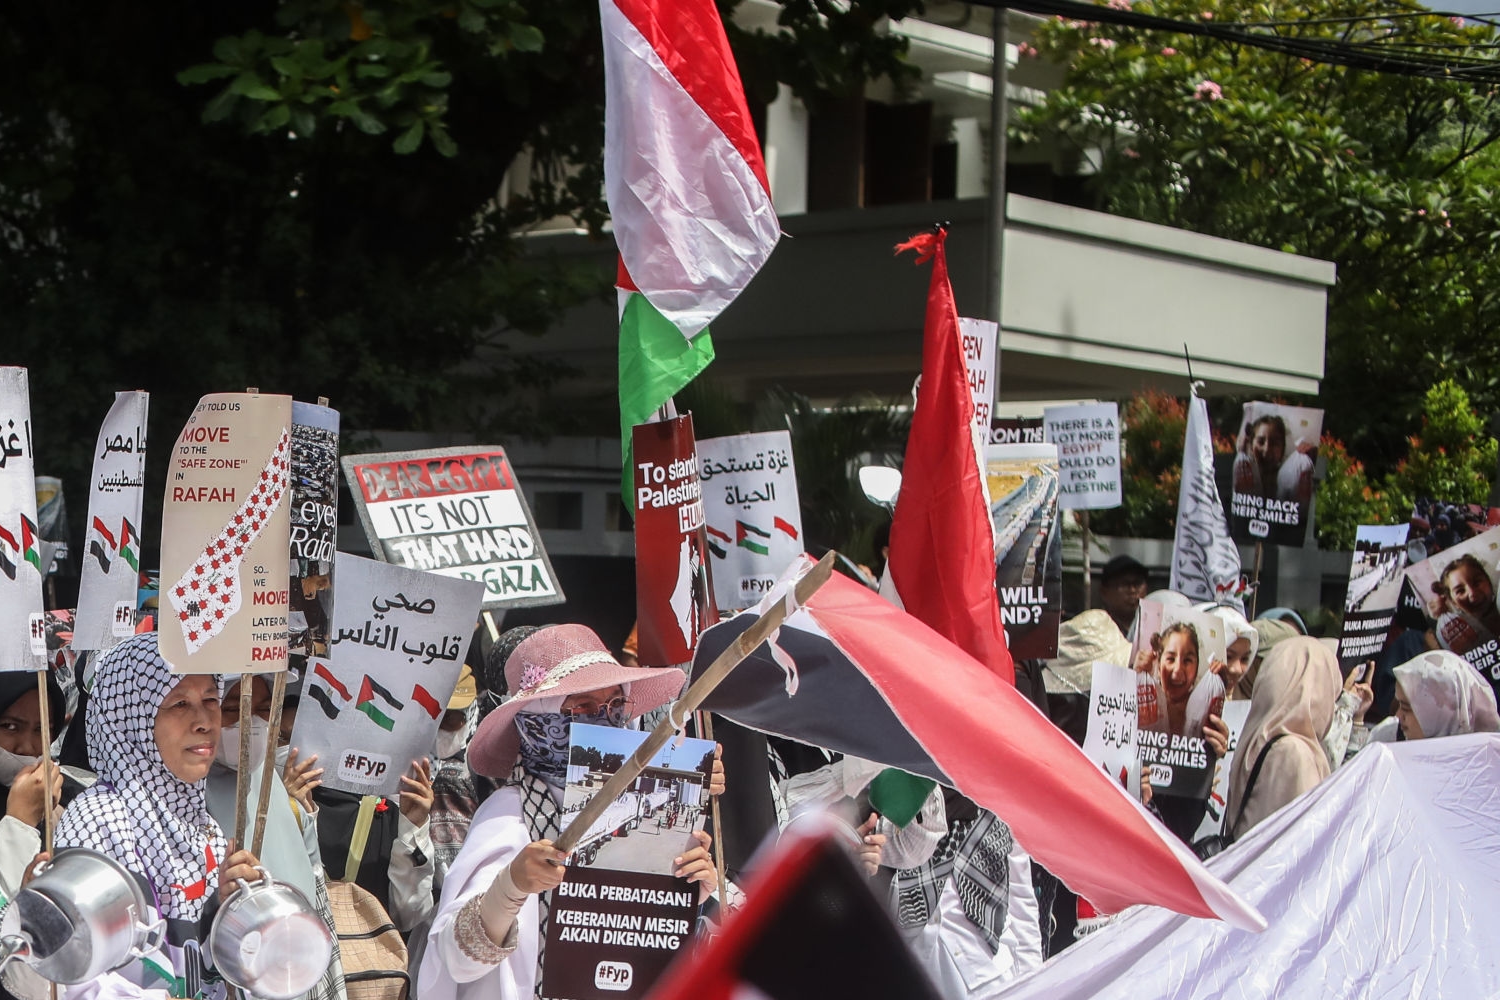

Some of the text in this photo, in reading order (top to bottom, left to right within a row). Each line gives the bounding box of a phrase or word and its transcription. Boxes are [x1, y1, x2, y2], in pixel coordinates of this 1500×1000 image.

[963, 335, 983, 360] PEN
[208, 403, 227, 411] TOLD
[229, 403, 240, 411] US
[1048, 418, 1114, 431] THERE IS A
[181, 427, 230, 443] MOVE
[1052, 431, 1115, 443] LOT MORE
[180, 446, 207, 455] TO THE
[1062, 443, 1102, 455] EGYPT
[700, 450, 789, 481] غزة تستحق
[1059, 456, 1115, 469] OULD DO
[361, 455, 506, 500] DEAR EGYPT
[638, 461, 666, 485] To
[1071, 470, 1096, 480] FOR
[173, 487, 235, 502] RAFAH
[725, 482, 776, 510] الحياة
[1060, 481, 1116, 494] ALESTINE
[390, 495, 493, 534] ITS NOT
[1266, 498, 1299, 513] BACK
[300, 501, 336, 532] eyes
[1259, 509, 1299, 525] SMILES
[392, 527, 535, 570] THAT HARD
[253, 579, 266, 587] WE
[482, 563, 549, 595] GAZA
[741, 578, 774, 592] #Fyp
[1000, 586, 1048, 605] WILL
[252, 617, 278, 627] LATER
[1000, 605, 1042, 625] ND?
[252, 633, 272, 641] THEY
[331, 621, 462, 665] قلوب الناس
[1137, 730, 1168, 747] RING
[1171, 734, 1206, 753] BACK
[344, 754, 387, 777] #Fyp
[1160, 748, 1207, 769] SMILES
[558, 881, 692, 907] BUKA PERBATASAN!
[556, 909, 689, 935] KEBERANIAN MESIR
[559, 927, 681, 950] AKAN DIKENANG
[599, 965, 629, 983] #Fyp
